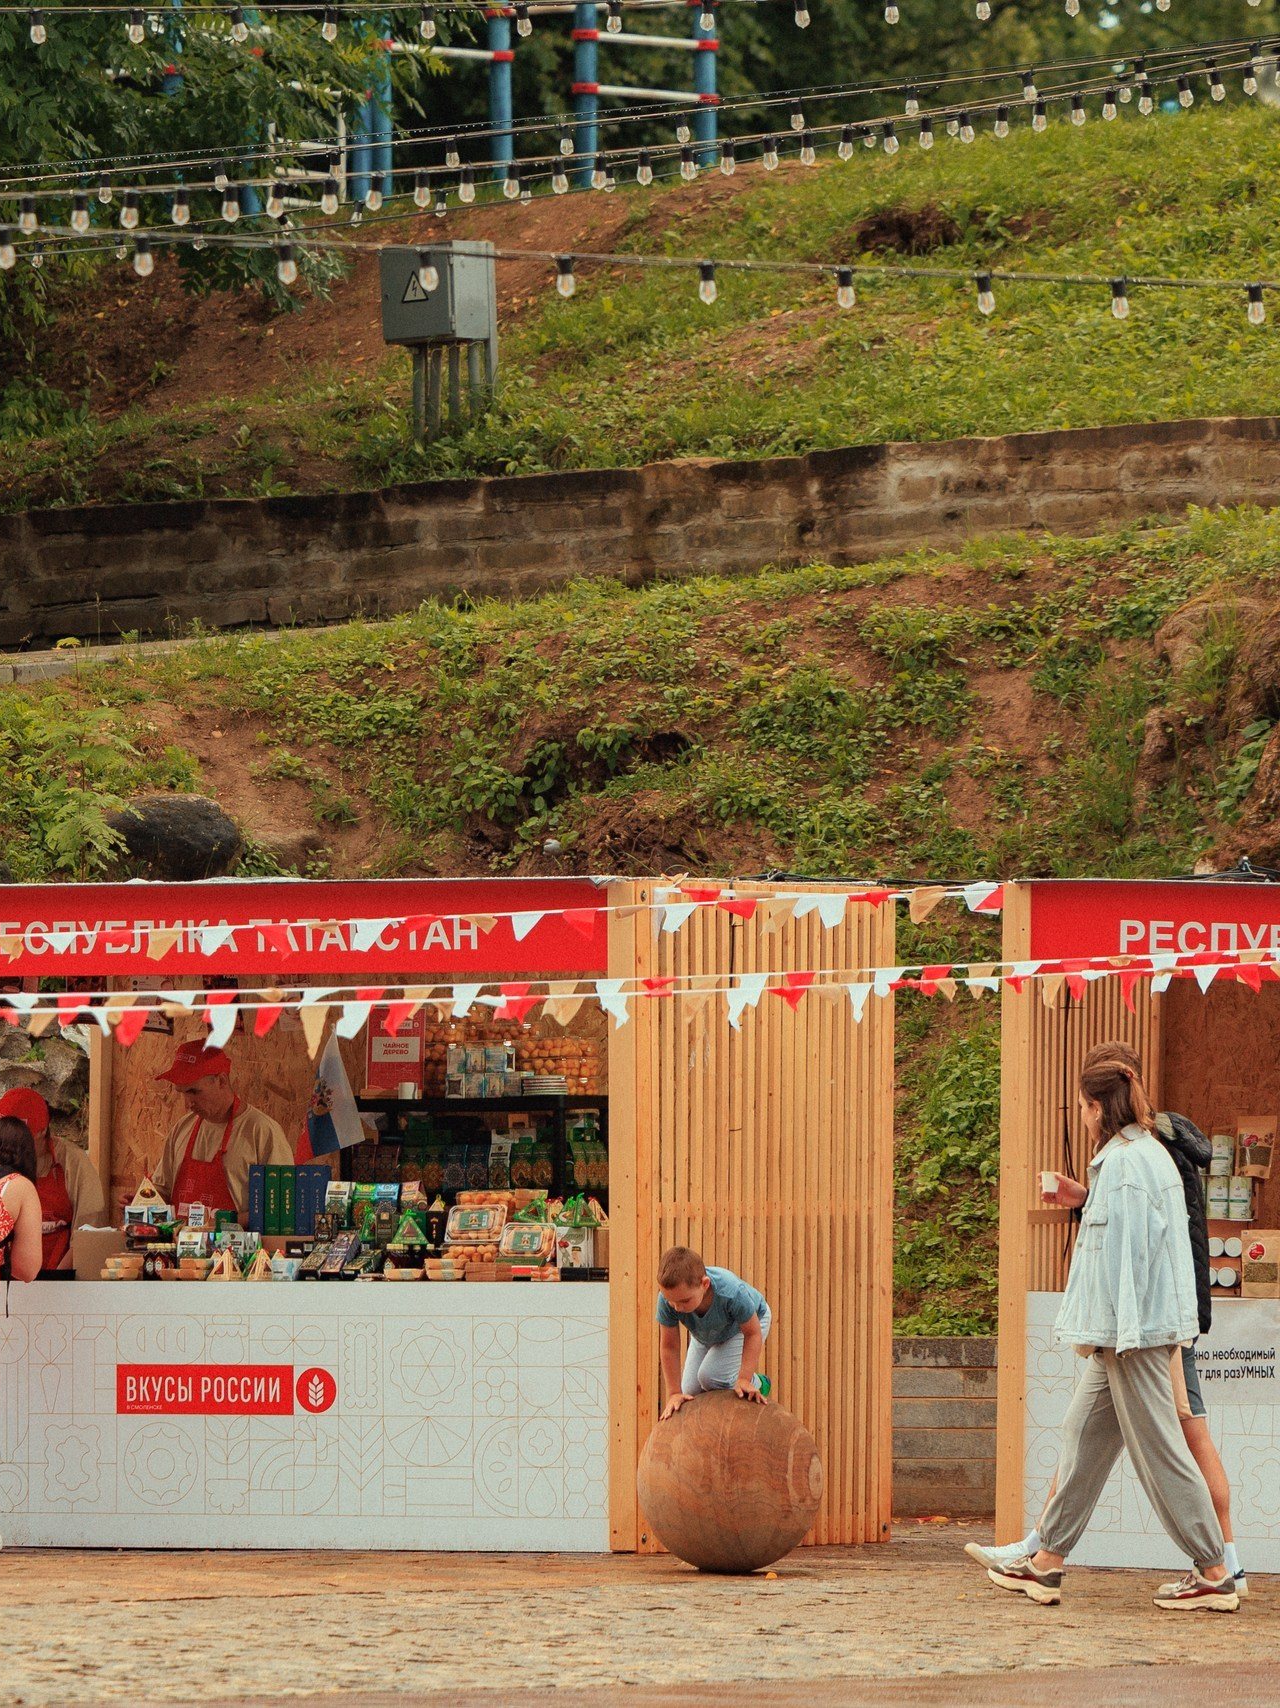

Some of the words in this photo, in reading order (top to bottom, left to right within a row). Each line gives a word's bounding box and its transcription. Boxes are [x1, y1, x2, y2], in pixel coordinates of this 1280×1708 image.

[1212, 1347, 1276, 1362] необходимый
[1205, 1369, 1222, 1381] для
[1224, 1365, 1275, 1382] разУМНЫХ
[126, 1376, 192, 1402] ВКУСЫ
[201, 1376, 280, 1403] РОССИИ
